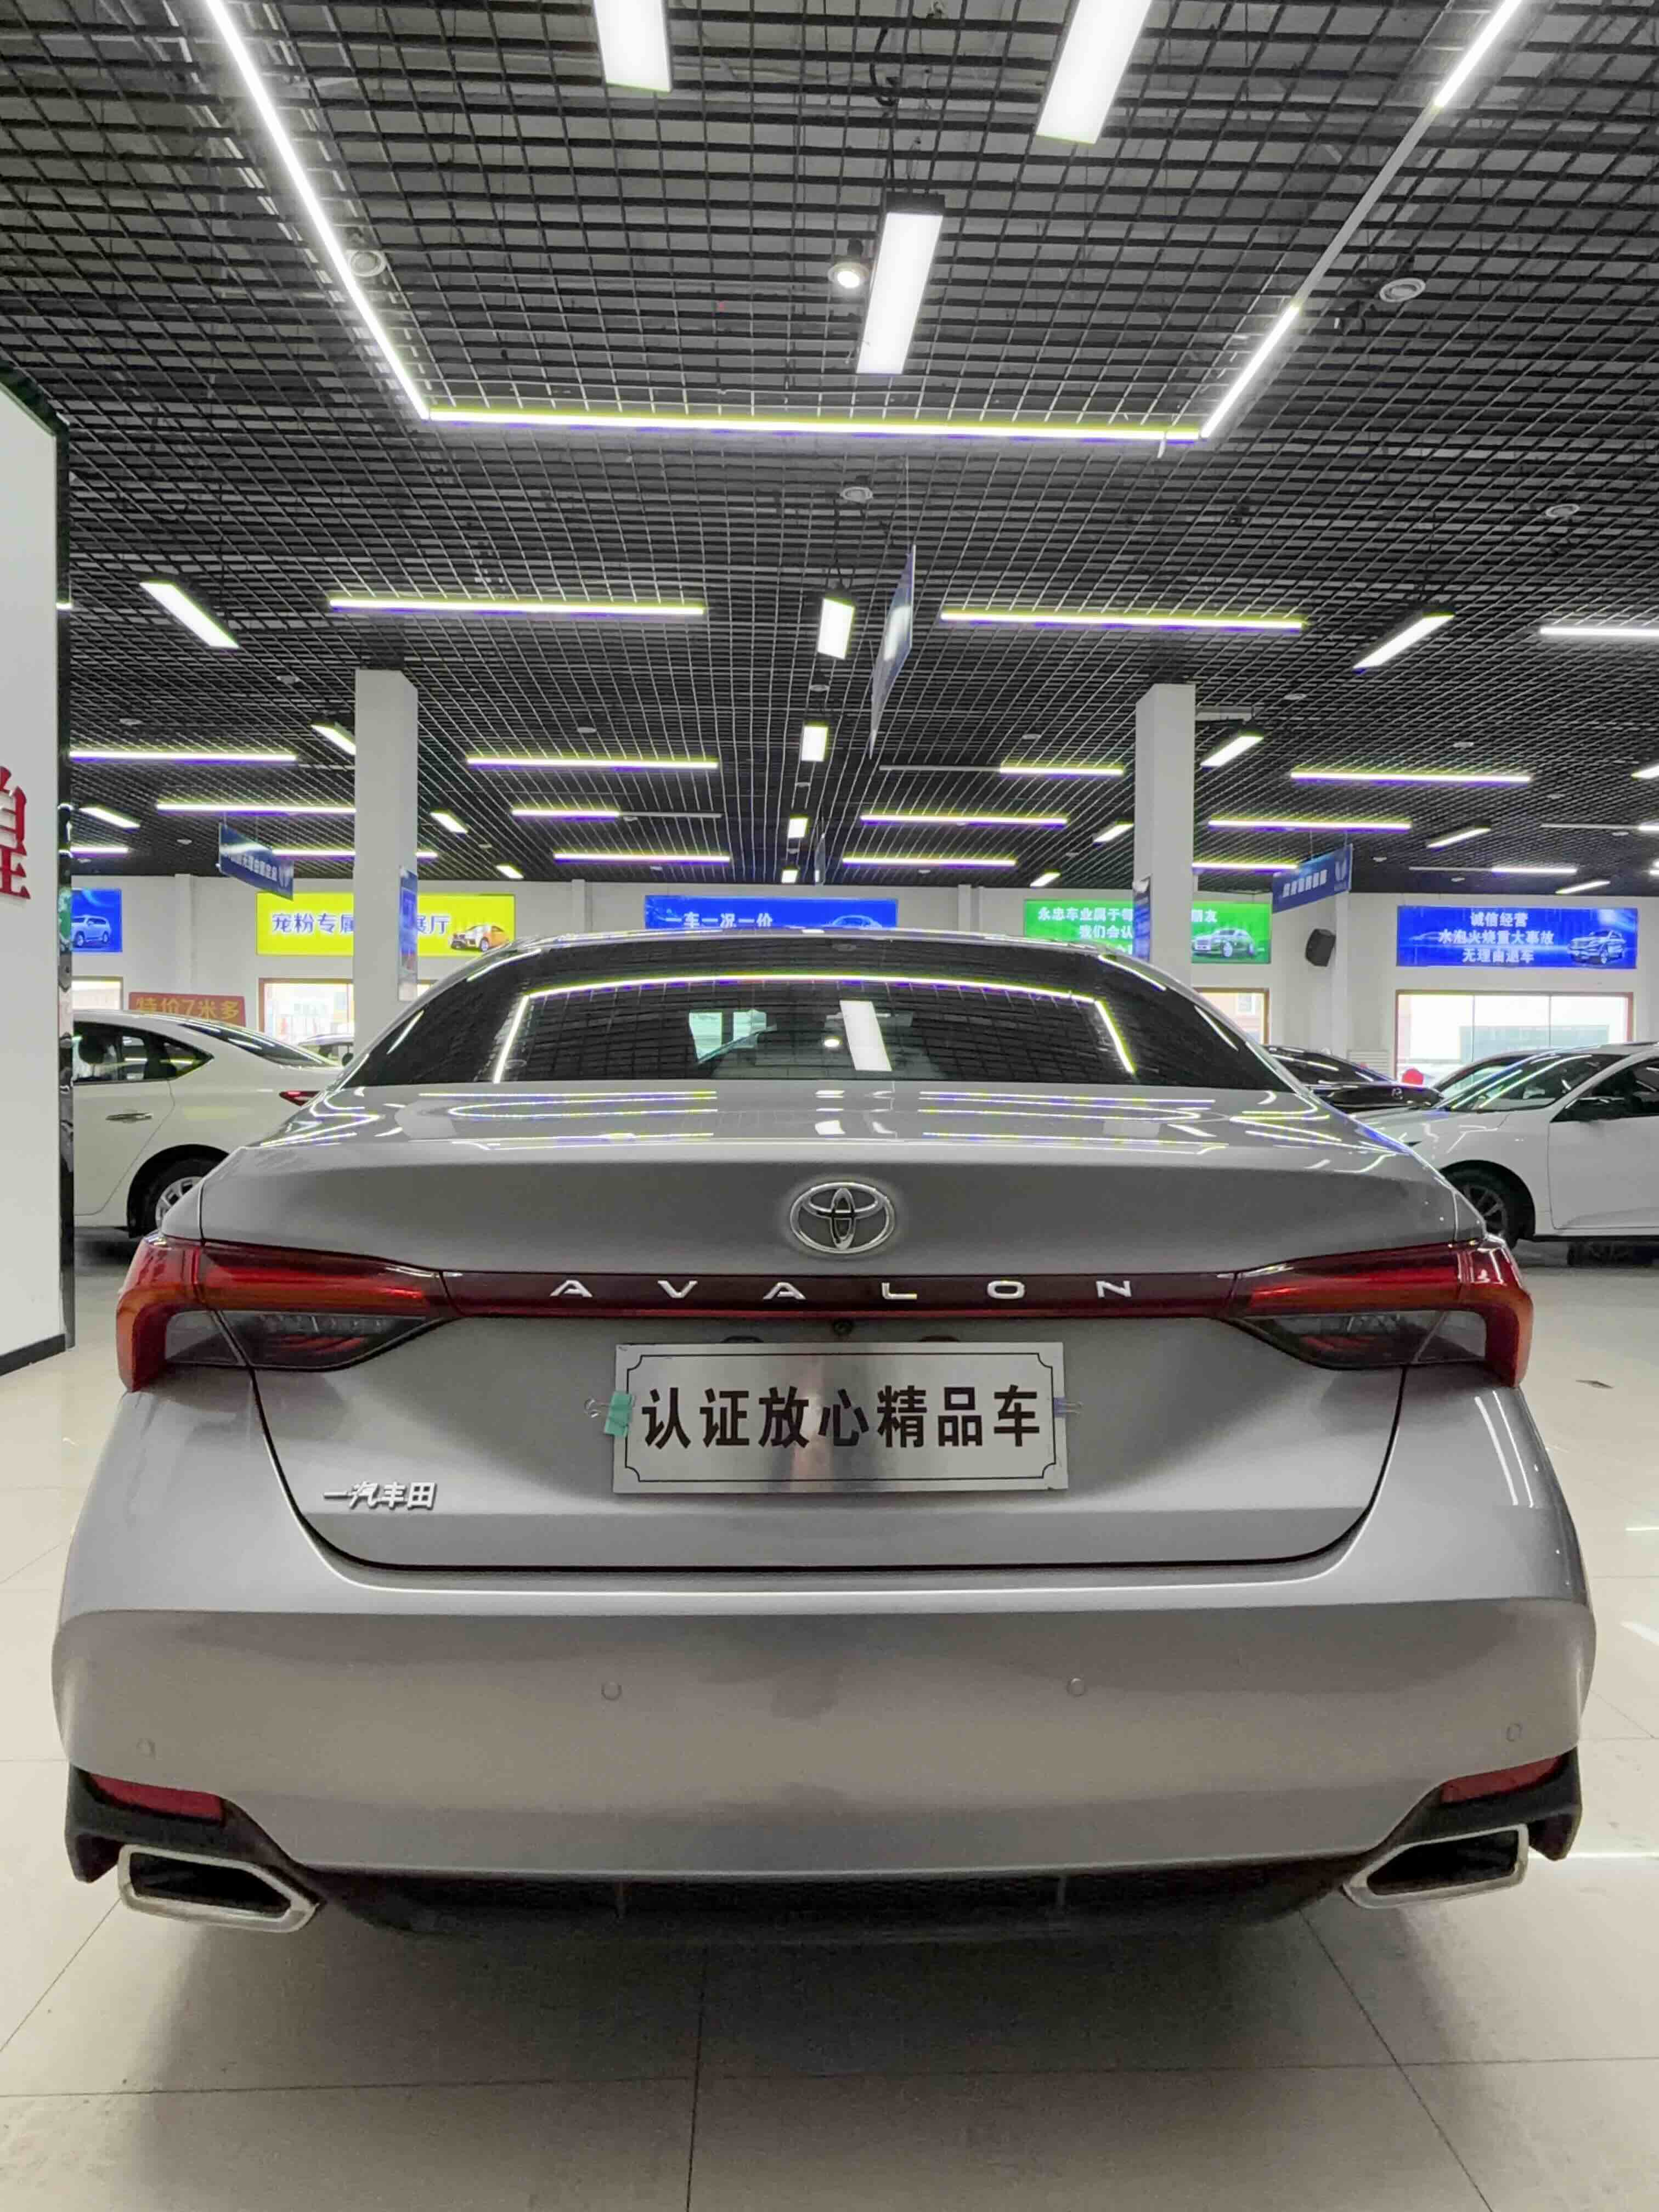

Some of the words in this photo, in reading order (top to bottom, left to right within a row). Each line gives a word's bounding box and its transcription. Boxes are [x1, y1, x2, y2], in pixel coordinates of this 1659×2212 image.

[665, 912, 772, 928] 一车一况一价
[1470, 912, 1528, 927] 诚信经营
[1438, 929, 1554, 944] 水泡火烧重大事故
[1463, 948, 1534, 963] 无理由退车
[550, 1279, 1131, 1300] AVALON
[641, 1384, 1040, 1449] 认证放心精品车
[323, 1481, 437, 1509] 一汽丰田
